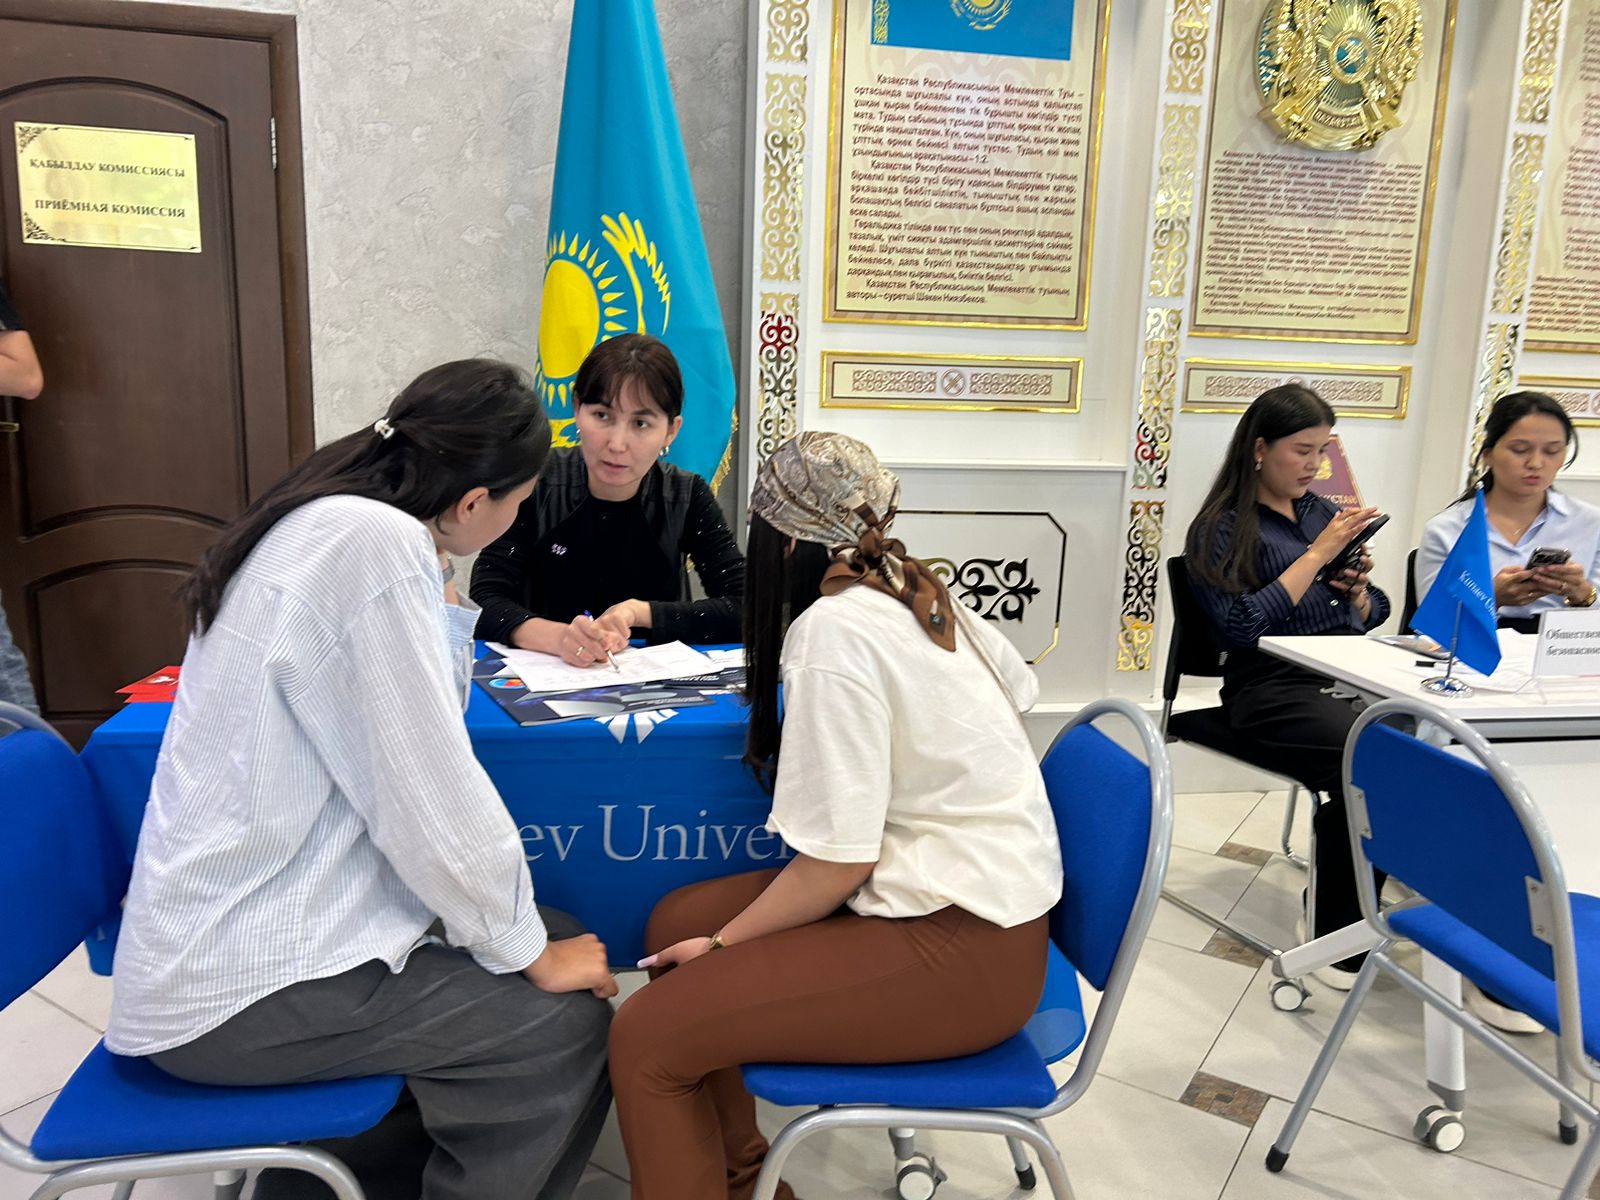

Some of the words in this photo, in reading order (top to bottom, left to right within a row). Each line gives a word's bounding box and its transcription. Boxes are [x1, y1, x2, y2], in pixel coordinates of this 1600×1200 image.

[876, 74, 919, 85] Қазақстан
[922, 78, 1000, 92] Республикасының
[1003, 84, 1054, 95] Мемлекеттік
[30, 158, 96, 171] ҚАБЫЛДАУ
[98, 163, 186, 178] КОМИССИЯСЫ
[870, 160, 912, 170] Қазақстан
[914, 163, 990, 175] Республикасының
[993, 167, 1042, 178] Мемлекеттік
[35, 199, 109, 213] ПРИЁМНАЯ
[112, 204, 186, 218] КОМИССИЯ
[865, 279, 906, 288] Қазақстан
[909, 280, 984, 293] Республикасының
[986, 284, 1035, 293] Мемлекеттік
[518, 824, 584, 861] ev
